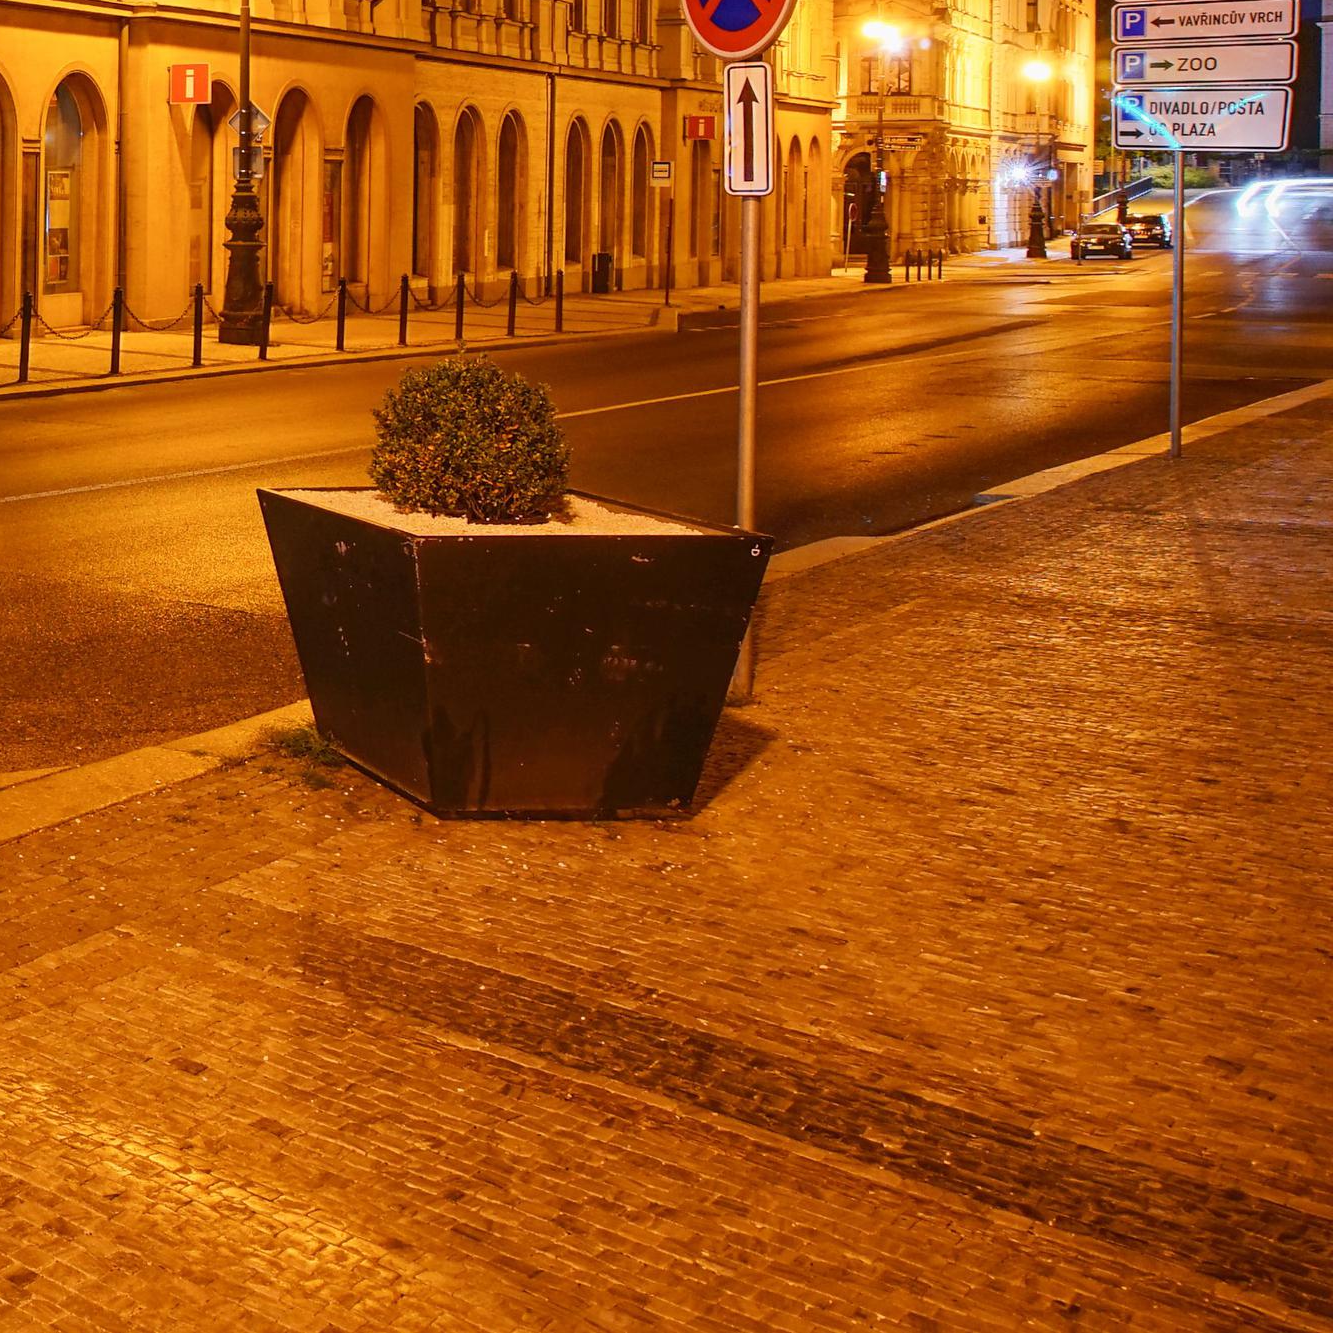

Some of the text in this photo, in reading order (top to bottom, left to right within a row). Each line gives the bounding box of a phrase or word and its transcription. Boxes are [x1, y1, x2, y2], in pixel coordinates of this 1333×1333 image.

[1249, 10, 1283, 24] VRCH
[1177, 57, 1218, 72] ZOO
[1149, 98, 1265, 116] DIVADLO/POŠTA
[1172, 123, 1216, 136] PLAZA
